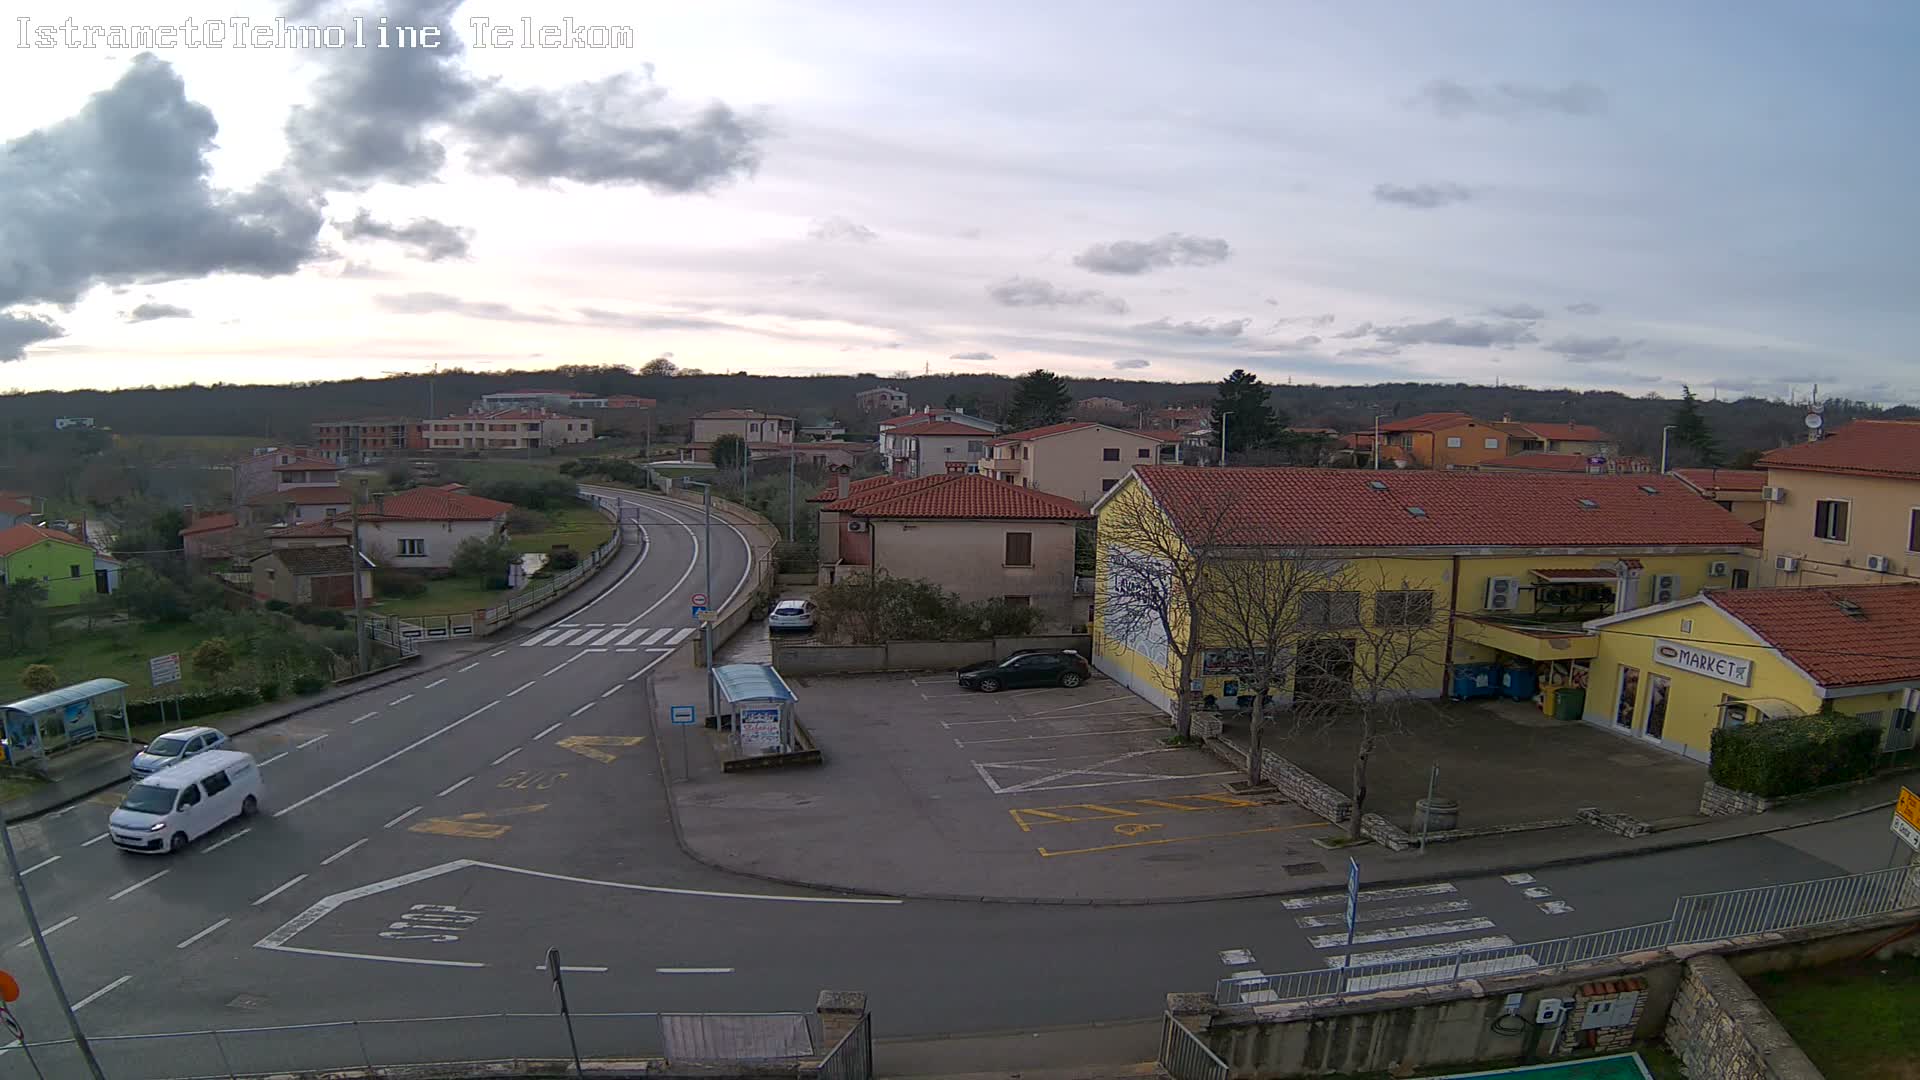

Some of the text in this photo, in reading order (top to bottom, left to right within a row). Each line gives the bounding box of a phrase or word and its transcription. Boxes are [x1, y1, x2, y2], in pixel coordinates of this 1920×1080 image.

[1678, 649, 1737, 678] MARKET
[495, 771, 569, 790] BUS
[378, 903, 484, 943] STOP
